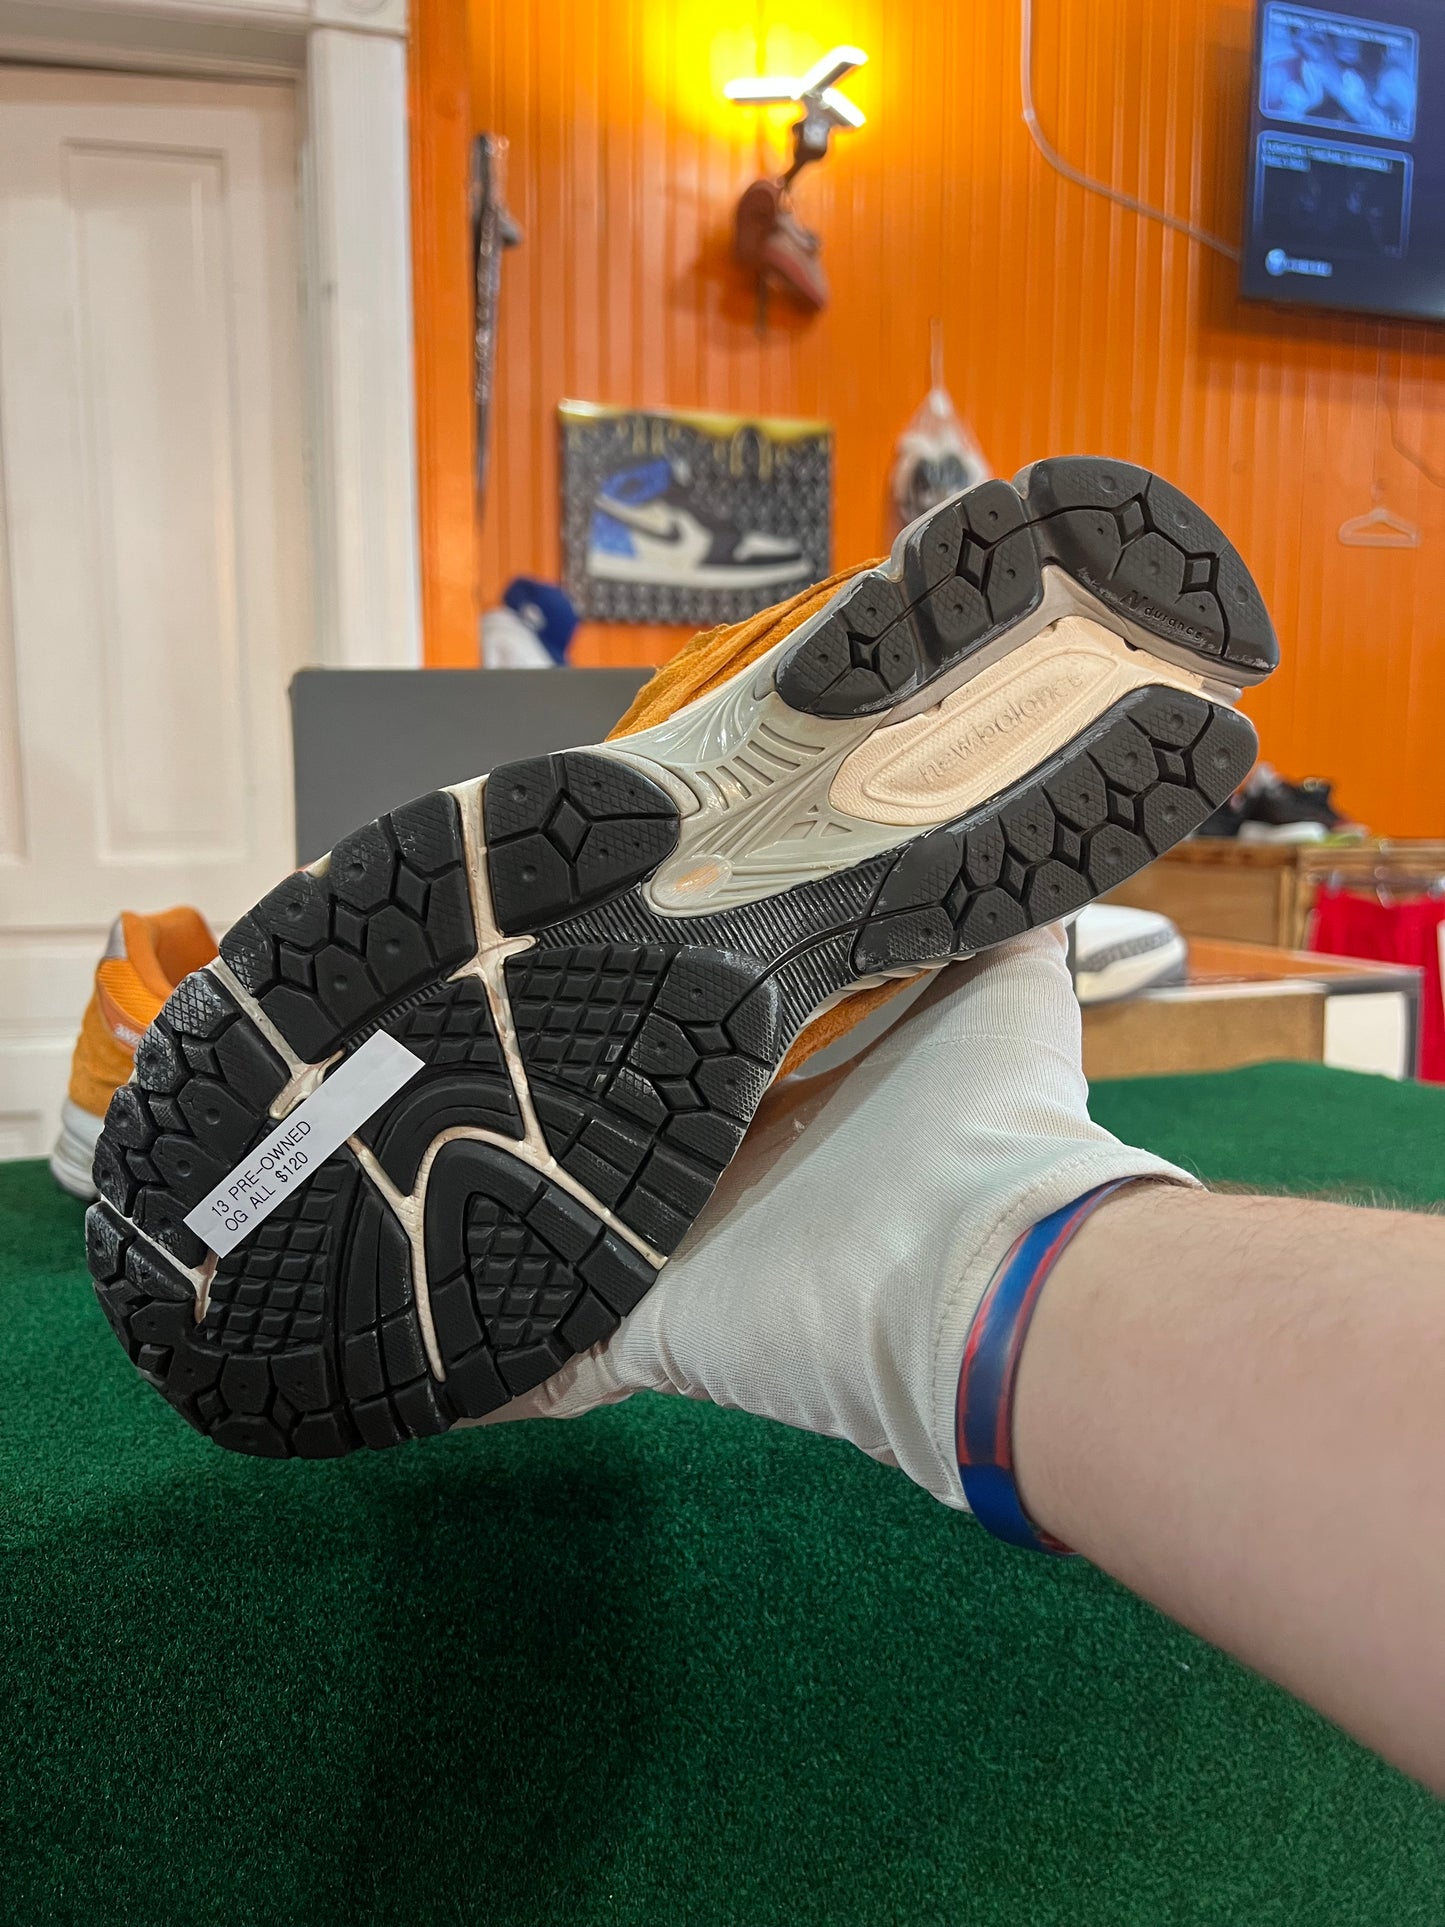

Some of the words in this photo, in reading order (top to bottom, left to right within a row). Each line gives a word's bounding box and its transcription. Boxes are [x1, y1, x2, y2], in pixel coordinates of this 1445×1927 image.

[211, 1199, 230, 1217] 13
[228, 1120, 311, 1201] PRE-OWNED
[224, 1209, 249, 1232] OG
[249, 1184, 276, 1210] ALL
[275, 1151, 309, 1183] $120
